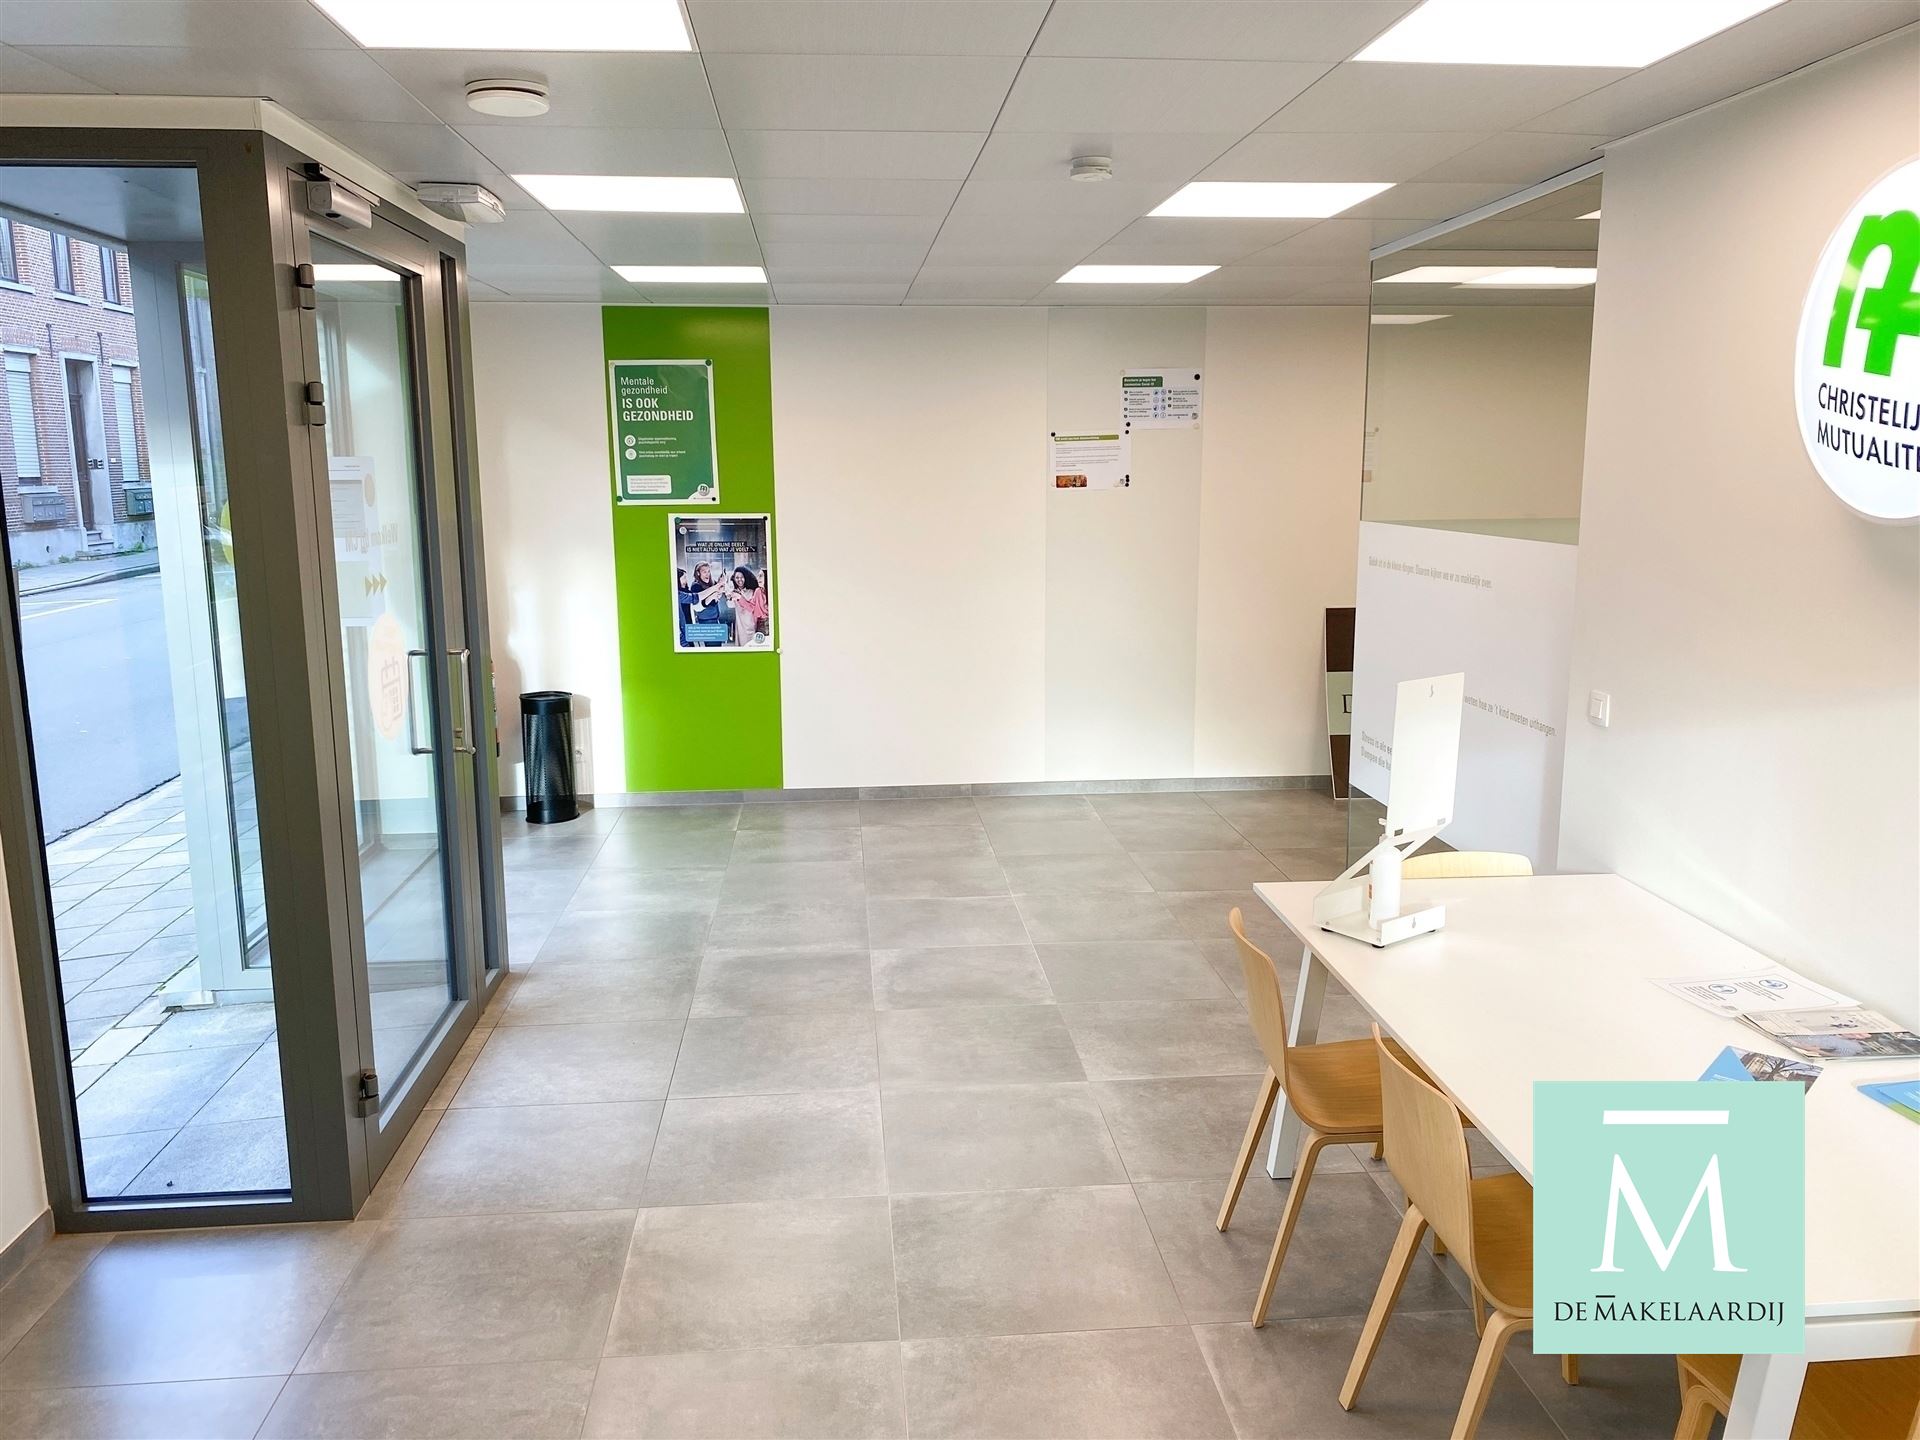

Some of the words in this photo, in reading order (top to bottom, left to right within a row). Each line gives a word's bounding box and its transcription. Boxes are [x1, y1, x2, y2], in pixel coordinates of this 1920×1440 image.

[621, 377, 654, 386] Mentale
[621, 386, 668, 396] gezondheid
[622, 398, 633, 409] IS
[636, 398, 659, 409] OOK
[623, 410, 694, 421] GEZONDHEID
